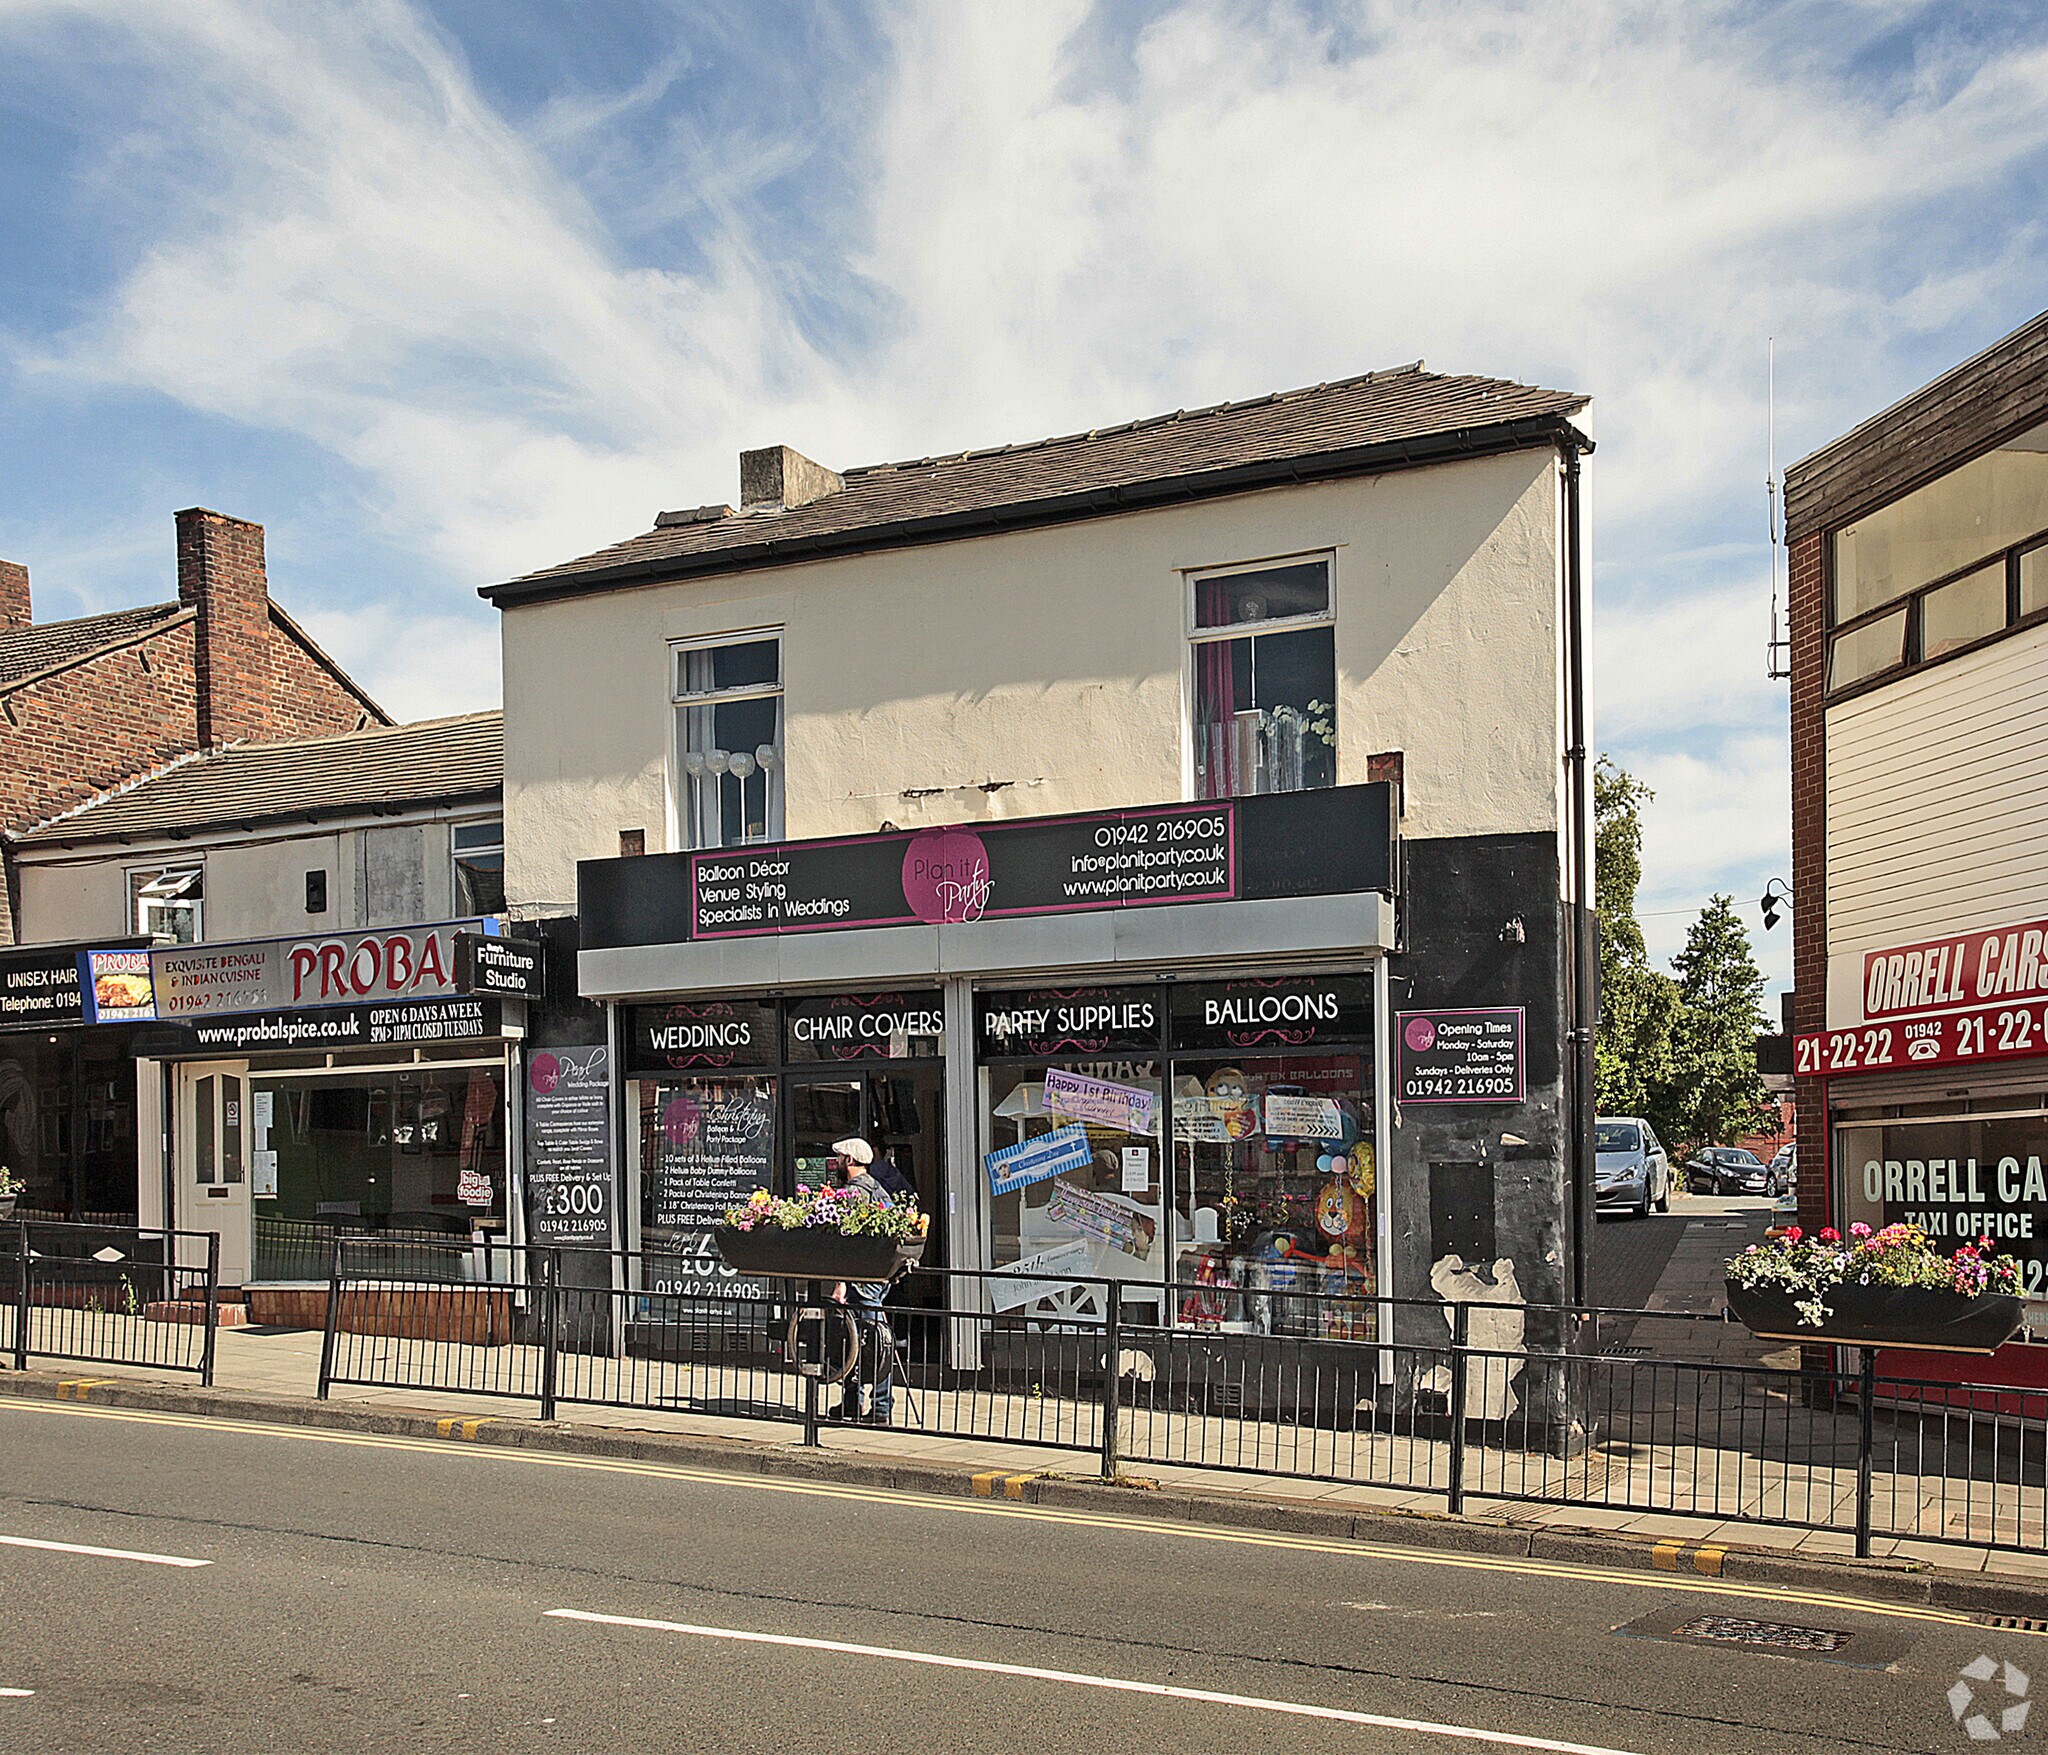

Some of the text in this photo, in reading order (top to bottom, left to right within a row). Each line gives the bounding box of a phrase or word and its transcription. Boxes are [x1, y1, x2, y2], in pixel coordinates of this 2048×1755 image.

[1094, 816, 1225, 847] 01942 216905
[1071, 843, 1225, 873] info@planitparty.co.uk
[698, 860, 790, 882] Balloon Décor
[914, 859, 970, 880] Plan it
[936, 859, 995, 923] Party
[1063, 866, 1225, 896] www.planitparty.co.uk
[699, 882, 786, 903] Venue Styling
[699, 898, 850, 927] Specialists in Weddings
[165, 953, 265, 973] EXQUISTE BENGALI
[286, 927, 465, 1001] PROBA
[478, 947, 534, 970] Furniture
[7, 968, 78, 988] UNISEX HAIR
[182, 973, 217, 986] INDIAN
[219, 969, 261, 983] CUISINE
[486, 969, 526, 989] Studio
[1867, 943, 1966, 1014] ORRELL
[1, 996, 54, 1013] Telephone:
[169, 993, 211, 1011] 01942
[1205, 993, 1339, 1025] BALLOONS
[99, 1009, 129, 1019] 01942
[370, 1002, 483, 1025] OPEN 6 DAYS A WEEK
[985, 1003, 1154, 1036] PARTY SUPPLIES
[197, 1013, 360, 1047] www.probalspice.co.uk
[412, 1022, 443, 1039] CLOSED
[443, 1019, 483, 1037] TUESDAYS
[650, 1022, 751, 1050] WEDDINGS
[794, 1011, 943, 1042] CHAIR COVERS
[1437, 1022, 1512, 1036] Opening Times
[1905, 1021, 1942, 1039] 01942
[1437, 1040, 1470, 1050] Monday
[1477, 1039, 1514, 1049] Saturday
[1466, 1052, 1489, 1062] 10am
[1496, 1051, 1514, 1062] 5pm
[1290, 1069, 1354, 1080] BALLOONS
[1415, 1066, 1448, 1077] Sundays
[1454, 1065, 1493, 1074] Deliveries
[1494, 1064, 1514, 1075] Only
[1047, 1074, 1079, 1093] Happy
[1083, 1083, 1099, 1097] 1st
[1406, 1078, 1514, 1096] 01942 216905
[706, 1135, 720, 1143] Party
[707, 1125, 728, 1133] Balloon
[721, 1154, 738, 1164] Filled
[739, 1155, 767, 1164] Balloons
[463, 1172, 478, 1187] big
[529, 1174, 545, 1182] PLUS
[545, 1173, 560, 1182] FREE
[560, 1173, 584, 1183] Delivery
[585, 1173, 590, 1181] &
[591, 1172, 602, 1181] Set
[670, 1166, 689, 1175] Helium
[690, 1166, 706, 1176] Baby
[729, 1167, 757, 1175] Balloons
[1863, 1158, 1986, 1203] ORRELL
[460, 1185, 491, 1197] foodie
[669, 1178, 684, 1186] Pack
[685, 1178, 692, 1186] of
[693, 1178, 710, 1186] Table
[711, 1178, 737, 1187] Confetti
[546, 1184, 603, 1214] £300
[668, 1189, 686, 1198] Packs
[687, 1189, 693, 1198] of
[694, 1189, 729, 1199] Christening
[680, 1201, 714, 1211] Christening
[715, 1202, 726, 1210] Foil
[540, 1219, 607, 1232] 01942 216905
[657, 1213, 725, 1225] PLUS FREE Deliver
[1904, 1212, 2033, 1238] TAXI OFFICE
[656, 1280, 761, 1300] 01942 216905
